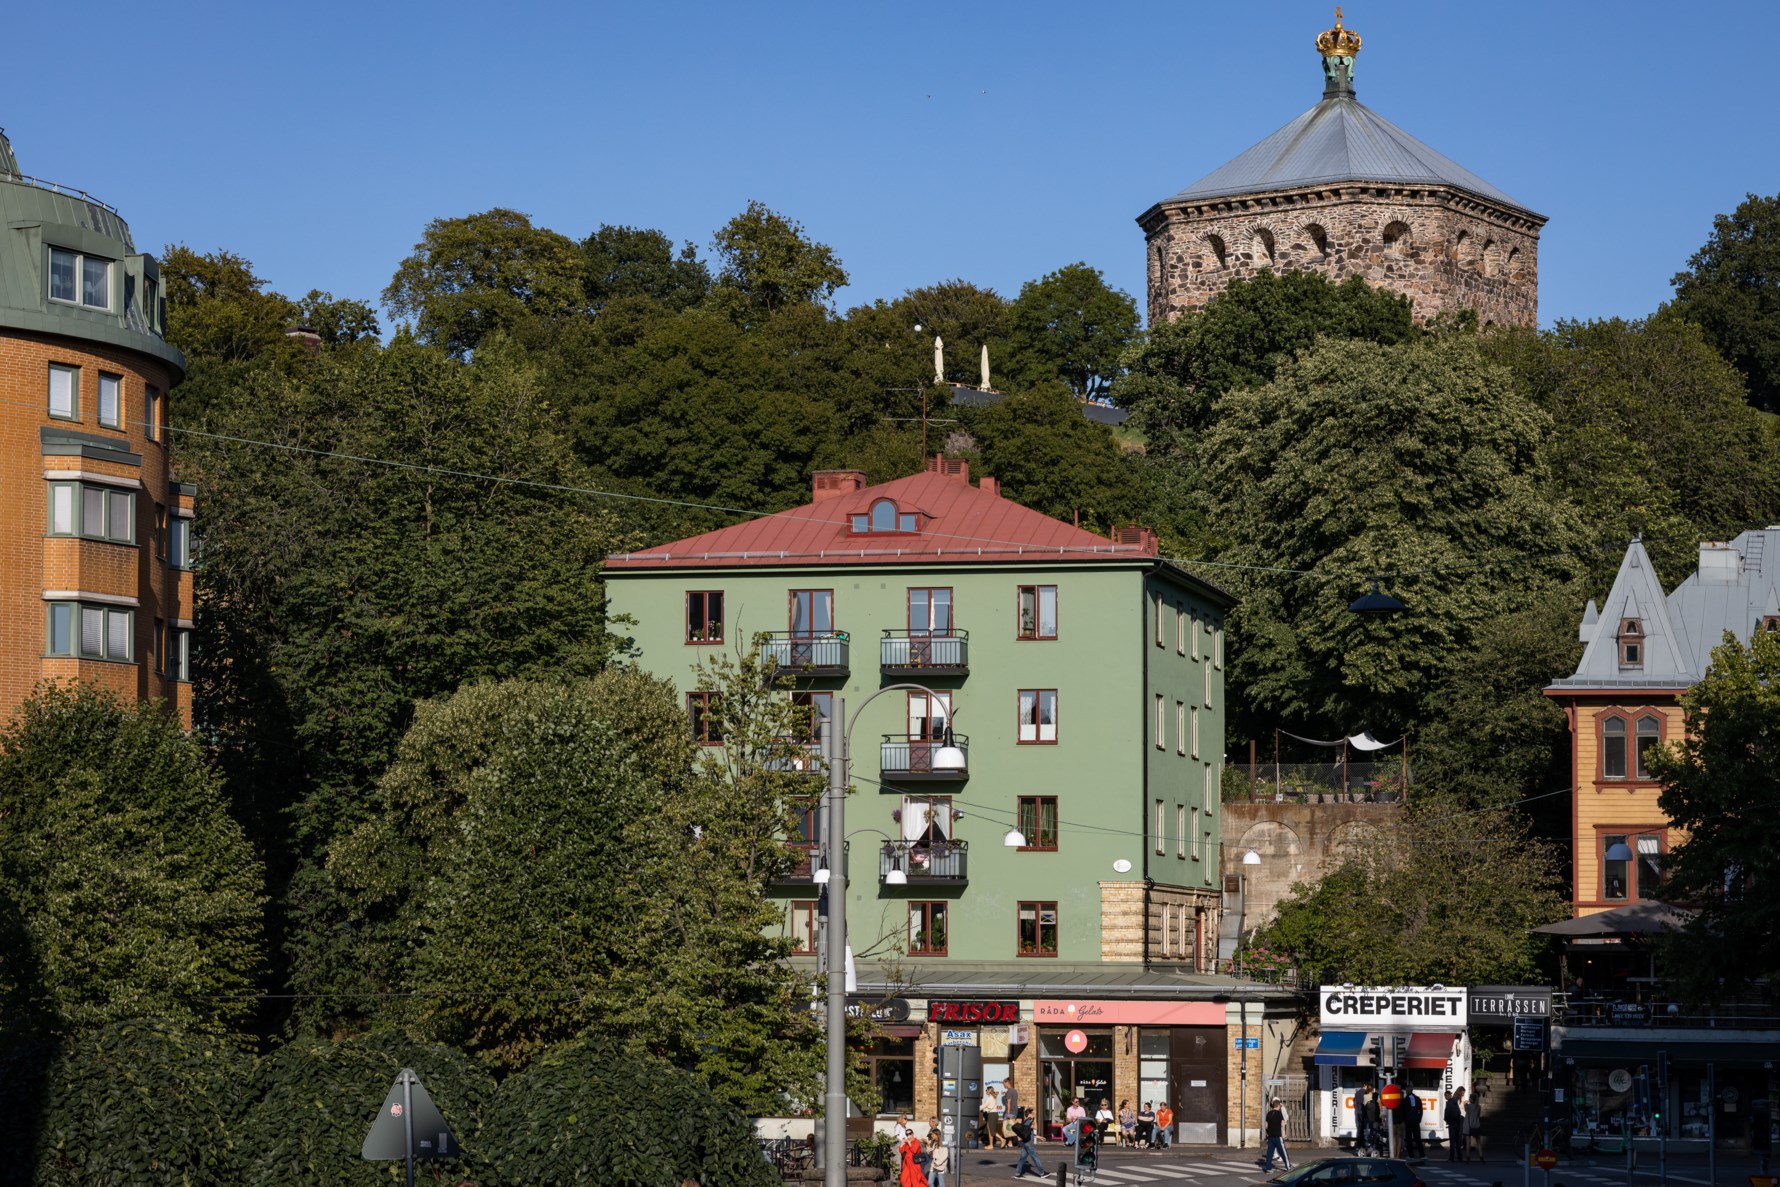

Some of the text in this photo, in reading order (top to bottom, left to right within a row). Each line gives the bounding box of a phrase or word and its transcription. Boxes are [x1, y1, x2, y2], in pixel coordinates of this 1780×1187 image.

[930, 1002, 1018, 1021] FRISÖR
[1040, 1005, 1105, 1021] RÅDA Gelato
[1474, 999, 1545, 1013] TERRASSEN
[946, 1030, 972, 1038] Asax
